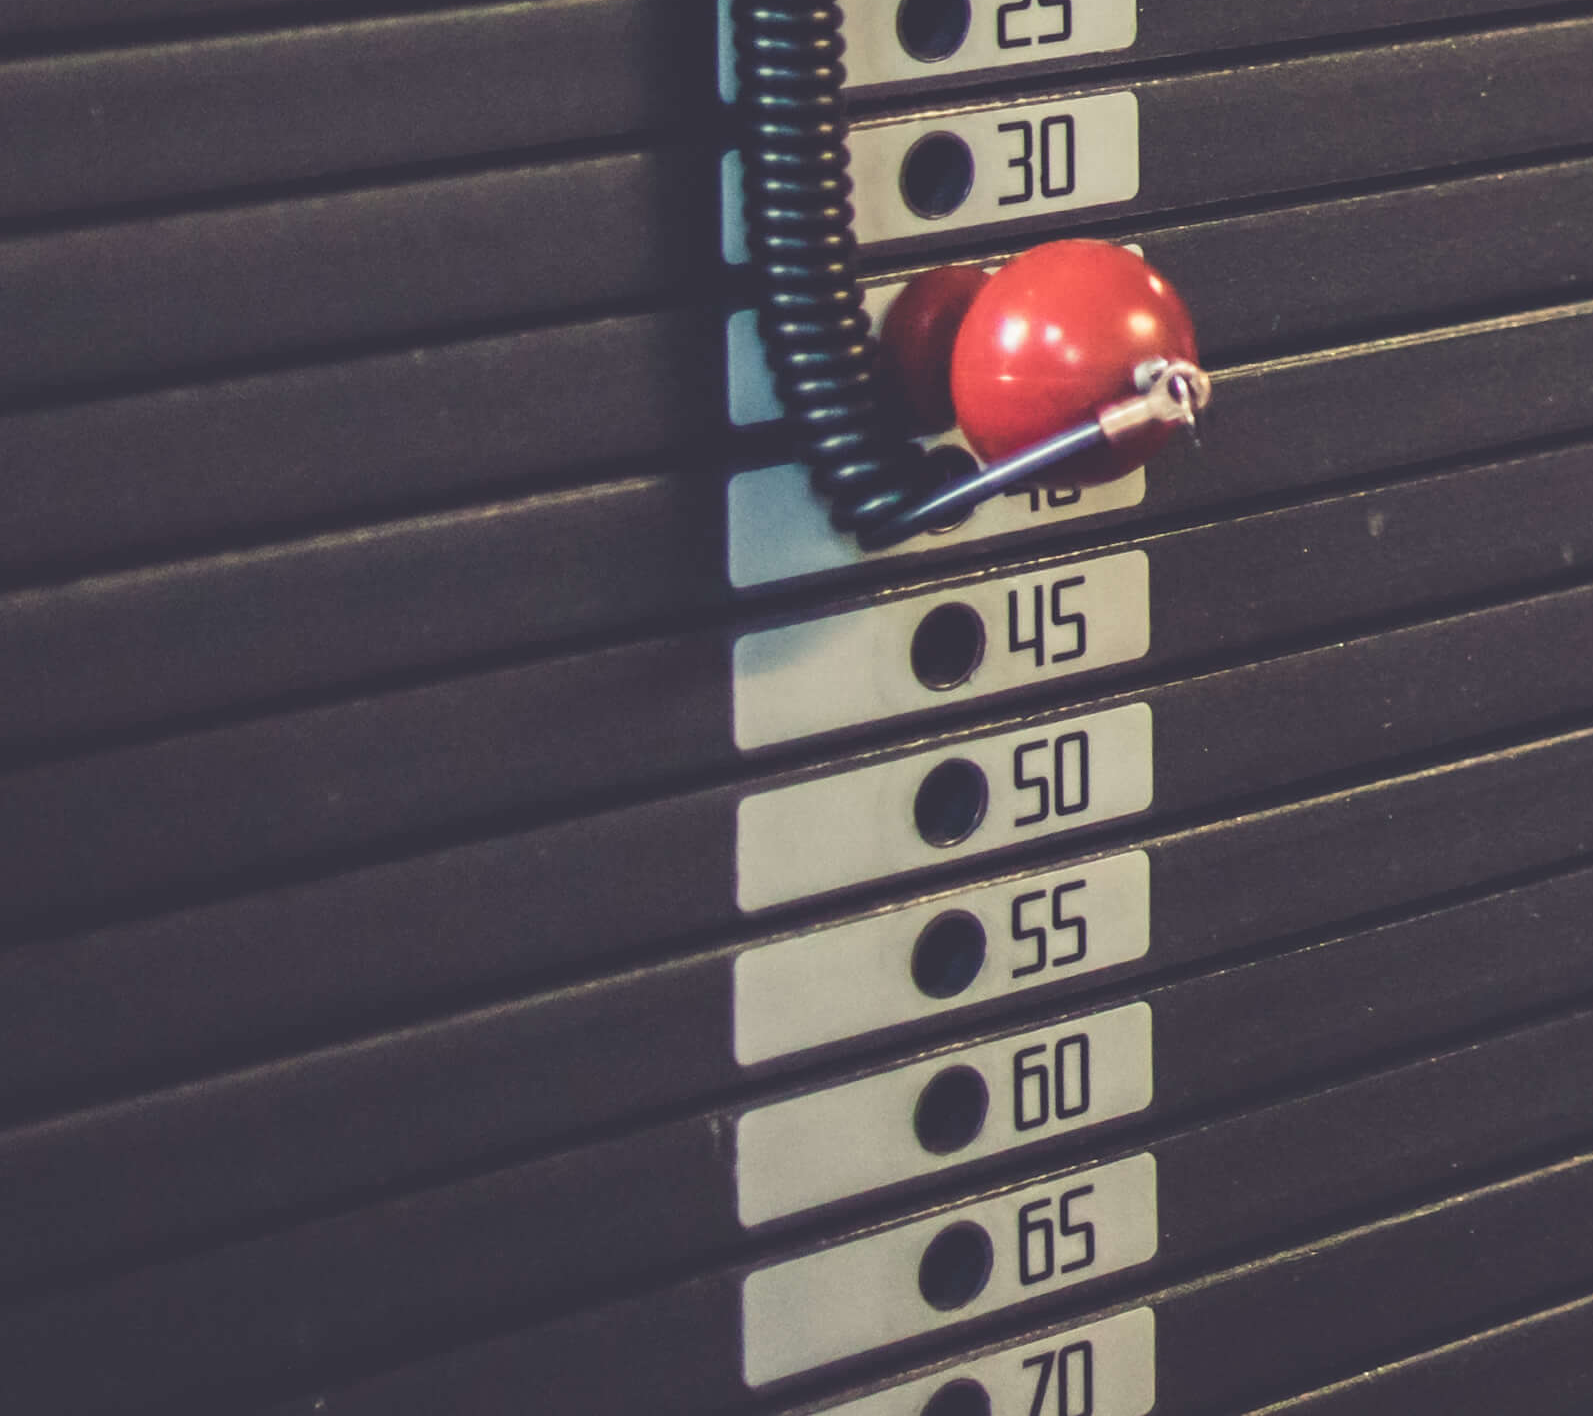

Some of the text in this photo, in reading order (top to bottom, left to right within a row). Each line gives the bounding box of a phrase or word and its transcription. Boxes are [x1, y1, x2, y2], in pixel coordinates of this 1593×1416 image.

[997, 113, 1075, 206] 30
[1007, 575, 1087, 667] 45
[1013, 729, 1090, 828] 50
[1011, 879, 1087, 979] 55
[1013, 1032, 1090, 1132] 60
[1018, 1184, 1096, 1286] 65
[1021, 1340, 1093, 1416] 70
